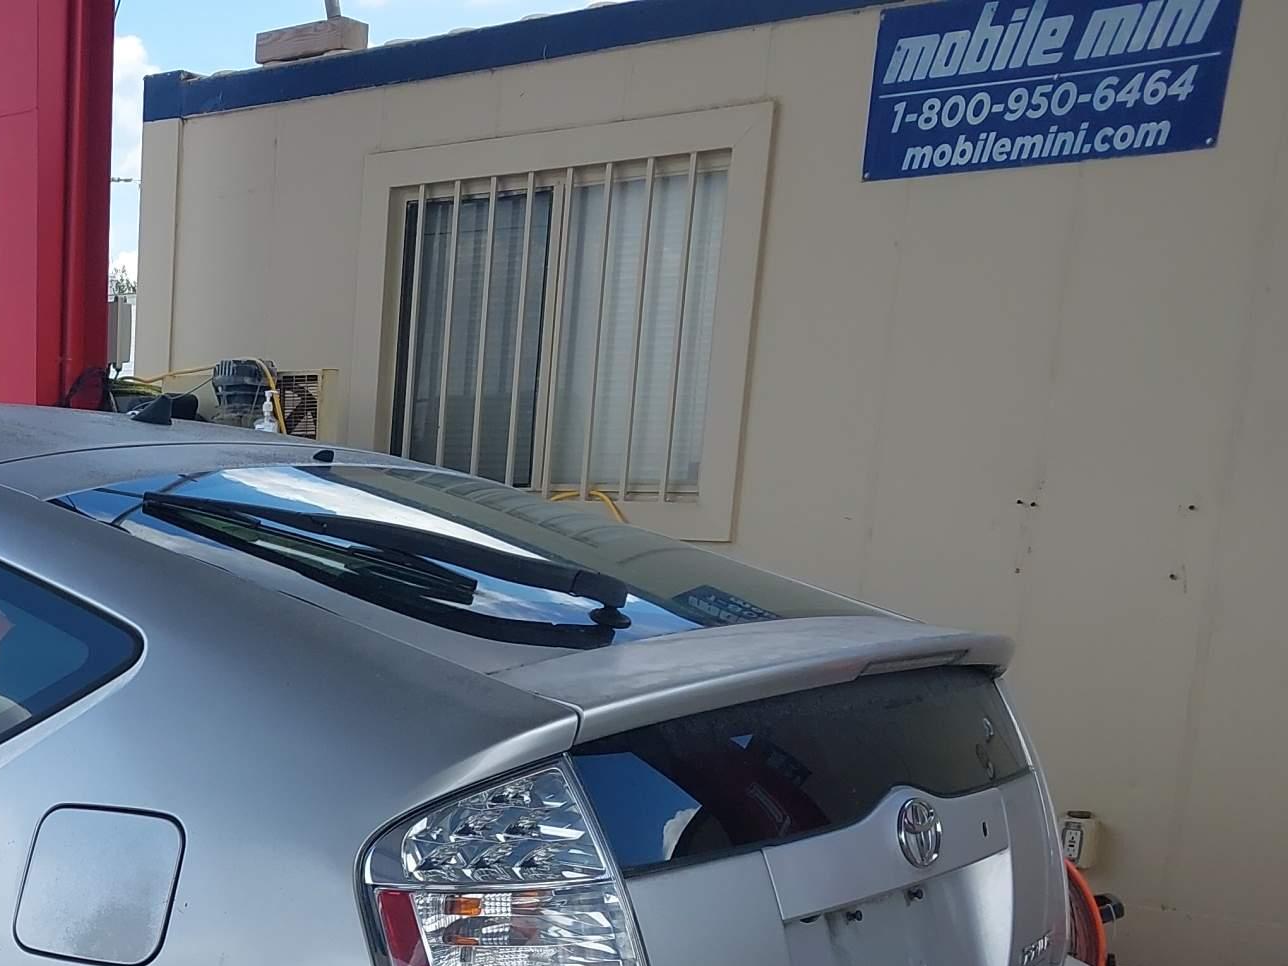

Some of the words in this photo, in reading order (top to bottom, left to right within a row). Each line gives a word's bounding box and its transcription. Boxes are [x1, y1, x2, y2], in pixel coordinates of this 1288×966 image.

[882, 0, 1074, 85] mobile
[1073, 0, 1221, 60] mini
[890, 64, 1199, 134] 1-800-950-6464
[901, 119, 1172, 171] mobilemini.com
